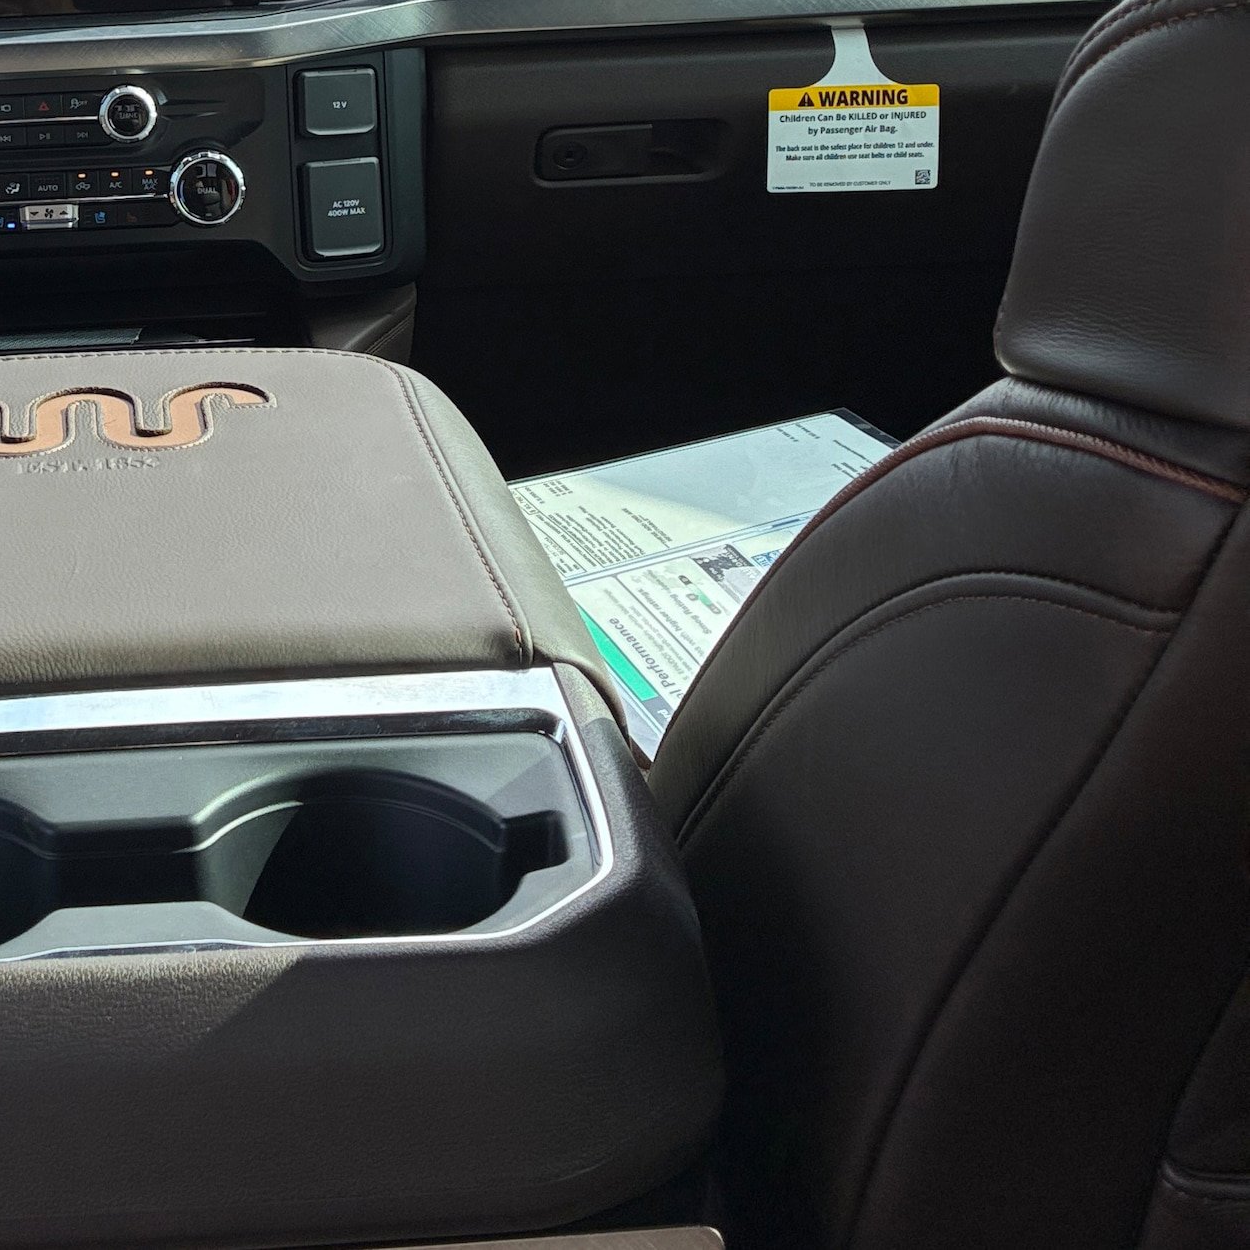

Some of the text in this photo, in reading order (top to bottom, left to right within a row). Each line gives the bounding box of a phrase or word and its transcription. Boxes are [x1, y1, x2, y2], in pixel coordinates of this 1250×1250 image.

[818, 89, 908, 106] WARNING
[332, 101, 341, 109] 12
[779, 114, 816, 122] Children
[817, 113, 834, 121] Can
[836, 113, 847, 121] Be
[848, 112, 877, 120] KILLED
[890, 111, 927, 121] INJURED
[808, 127, 818, 136] by
[820, 125, 863, 135] Passenger
[879, 125, 898, 134] Bag.
[848, 143, 862, 151] place
[38, 184, 59, 192] AUTO
[109, 181, 123, 189] A/C
[197, 186, 217, 195] DUAL
[328, 207, 365, 217] 400W MAX
[609, 617, 675, 687] Performance
